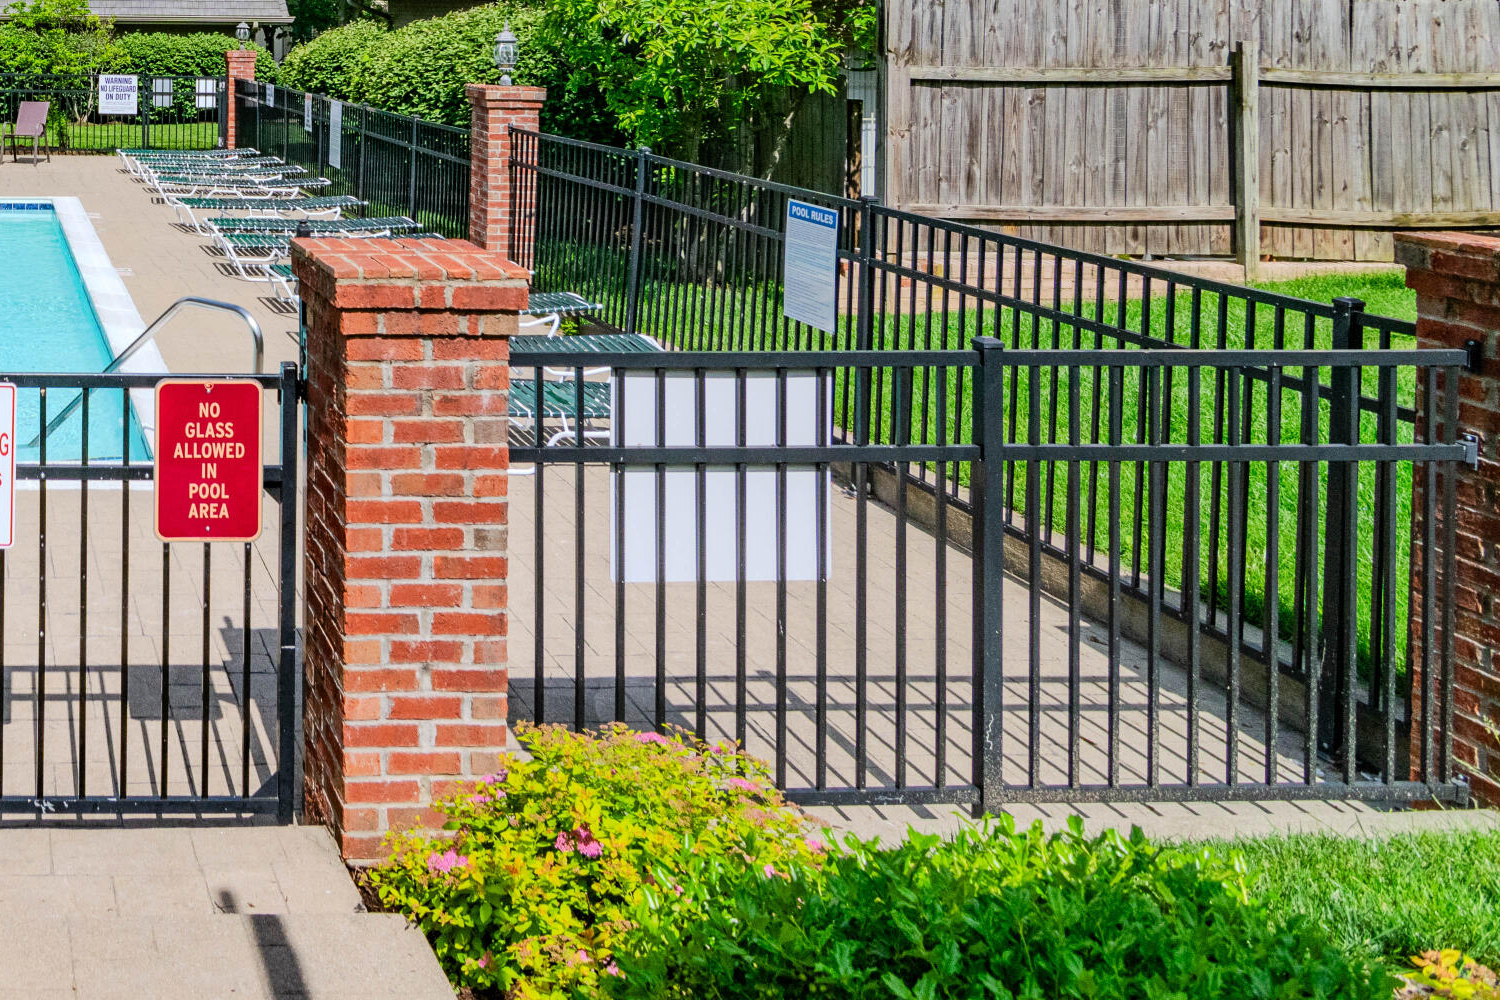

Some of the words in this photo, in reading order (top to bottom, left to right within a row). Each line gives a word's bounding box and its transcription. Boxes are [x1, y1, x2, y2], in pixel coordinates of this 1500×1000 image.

[100, 85, 108, 93] NO
[108, 85, 137, 93] LIFEGUARD
[105, 93, 114, 101] ON
[115, 93, 131, 101] DUTY
[791, 205, 810, 218] POOL
[811, 210, 834, 225] RULES
[199, 402, 221, 418] NO
[185, 422, 234, 439] GLASS
[173, 442, 246, 459] ALLOWED
[201, 462, 217, 479] IN
[189, 483, 230, 499] POOL
[188, 503, 230, 519] AREA
